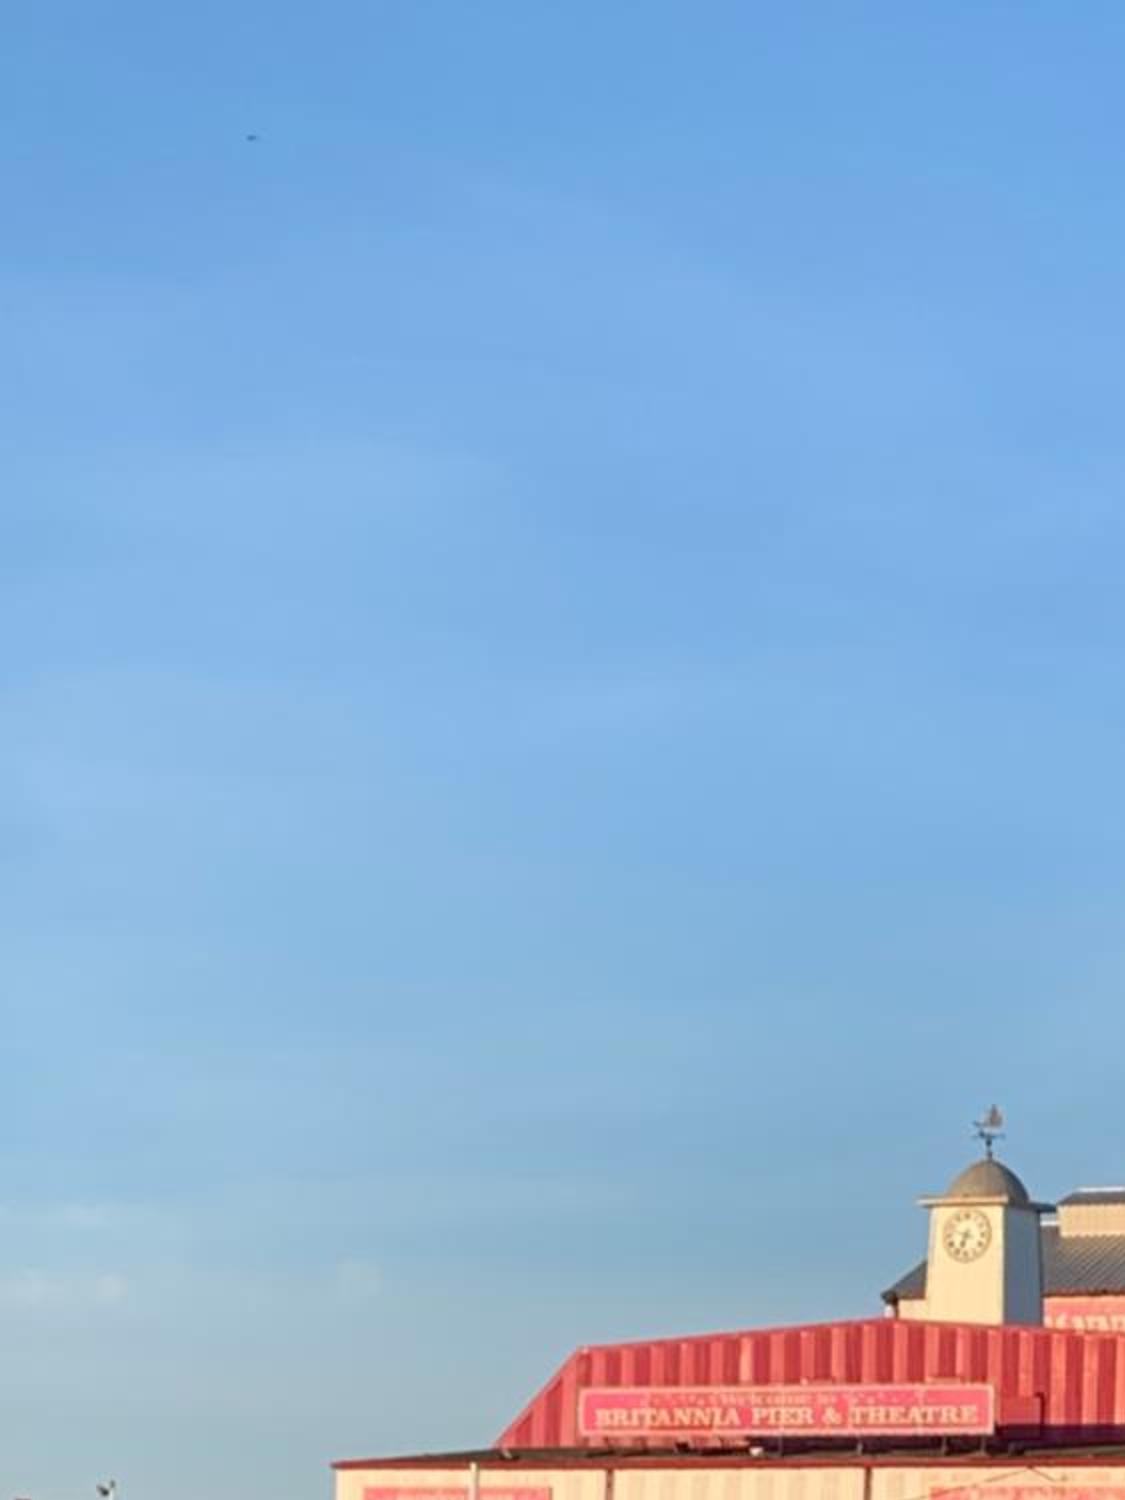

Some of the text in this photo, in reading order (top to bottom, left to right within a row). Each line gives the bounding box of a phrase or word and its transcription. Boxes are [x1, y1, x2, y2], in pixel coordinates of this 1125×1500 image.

[594, 1403, 979, 1427] BRITANNIA PIER & THEATRE
